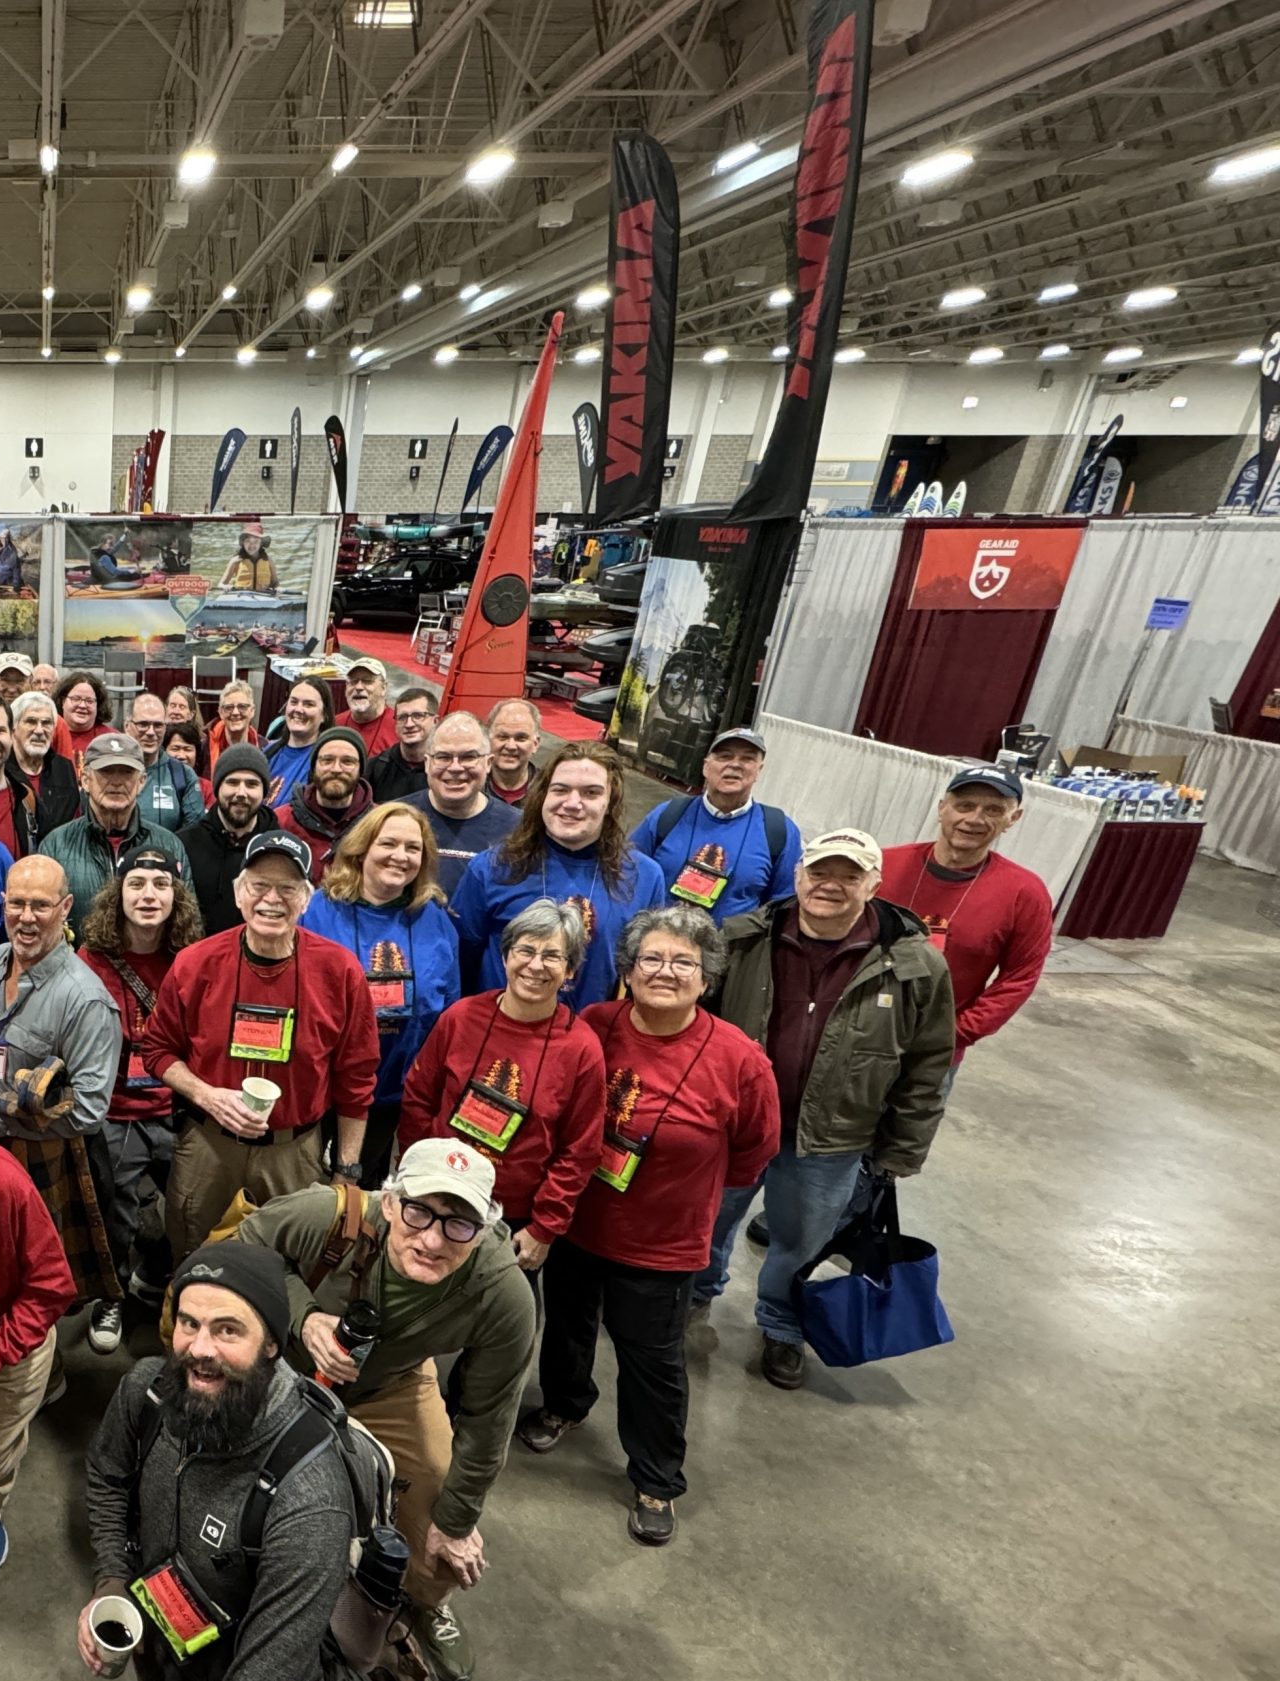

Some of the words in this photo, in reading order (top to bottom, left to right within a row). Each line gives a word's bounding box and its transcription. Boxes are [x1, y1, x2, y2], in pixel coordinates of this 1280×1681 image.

[605, 199, 656, 484] YAKIMA
[978, 539, 1003, 549] GEAR
[1003, 539, 1020, 549] AID
